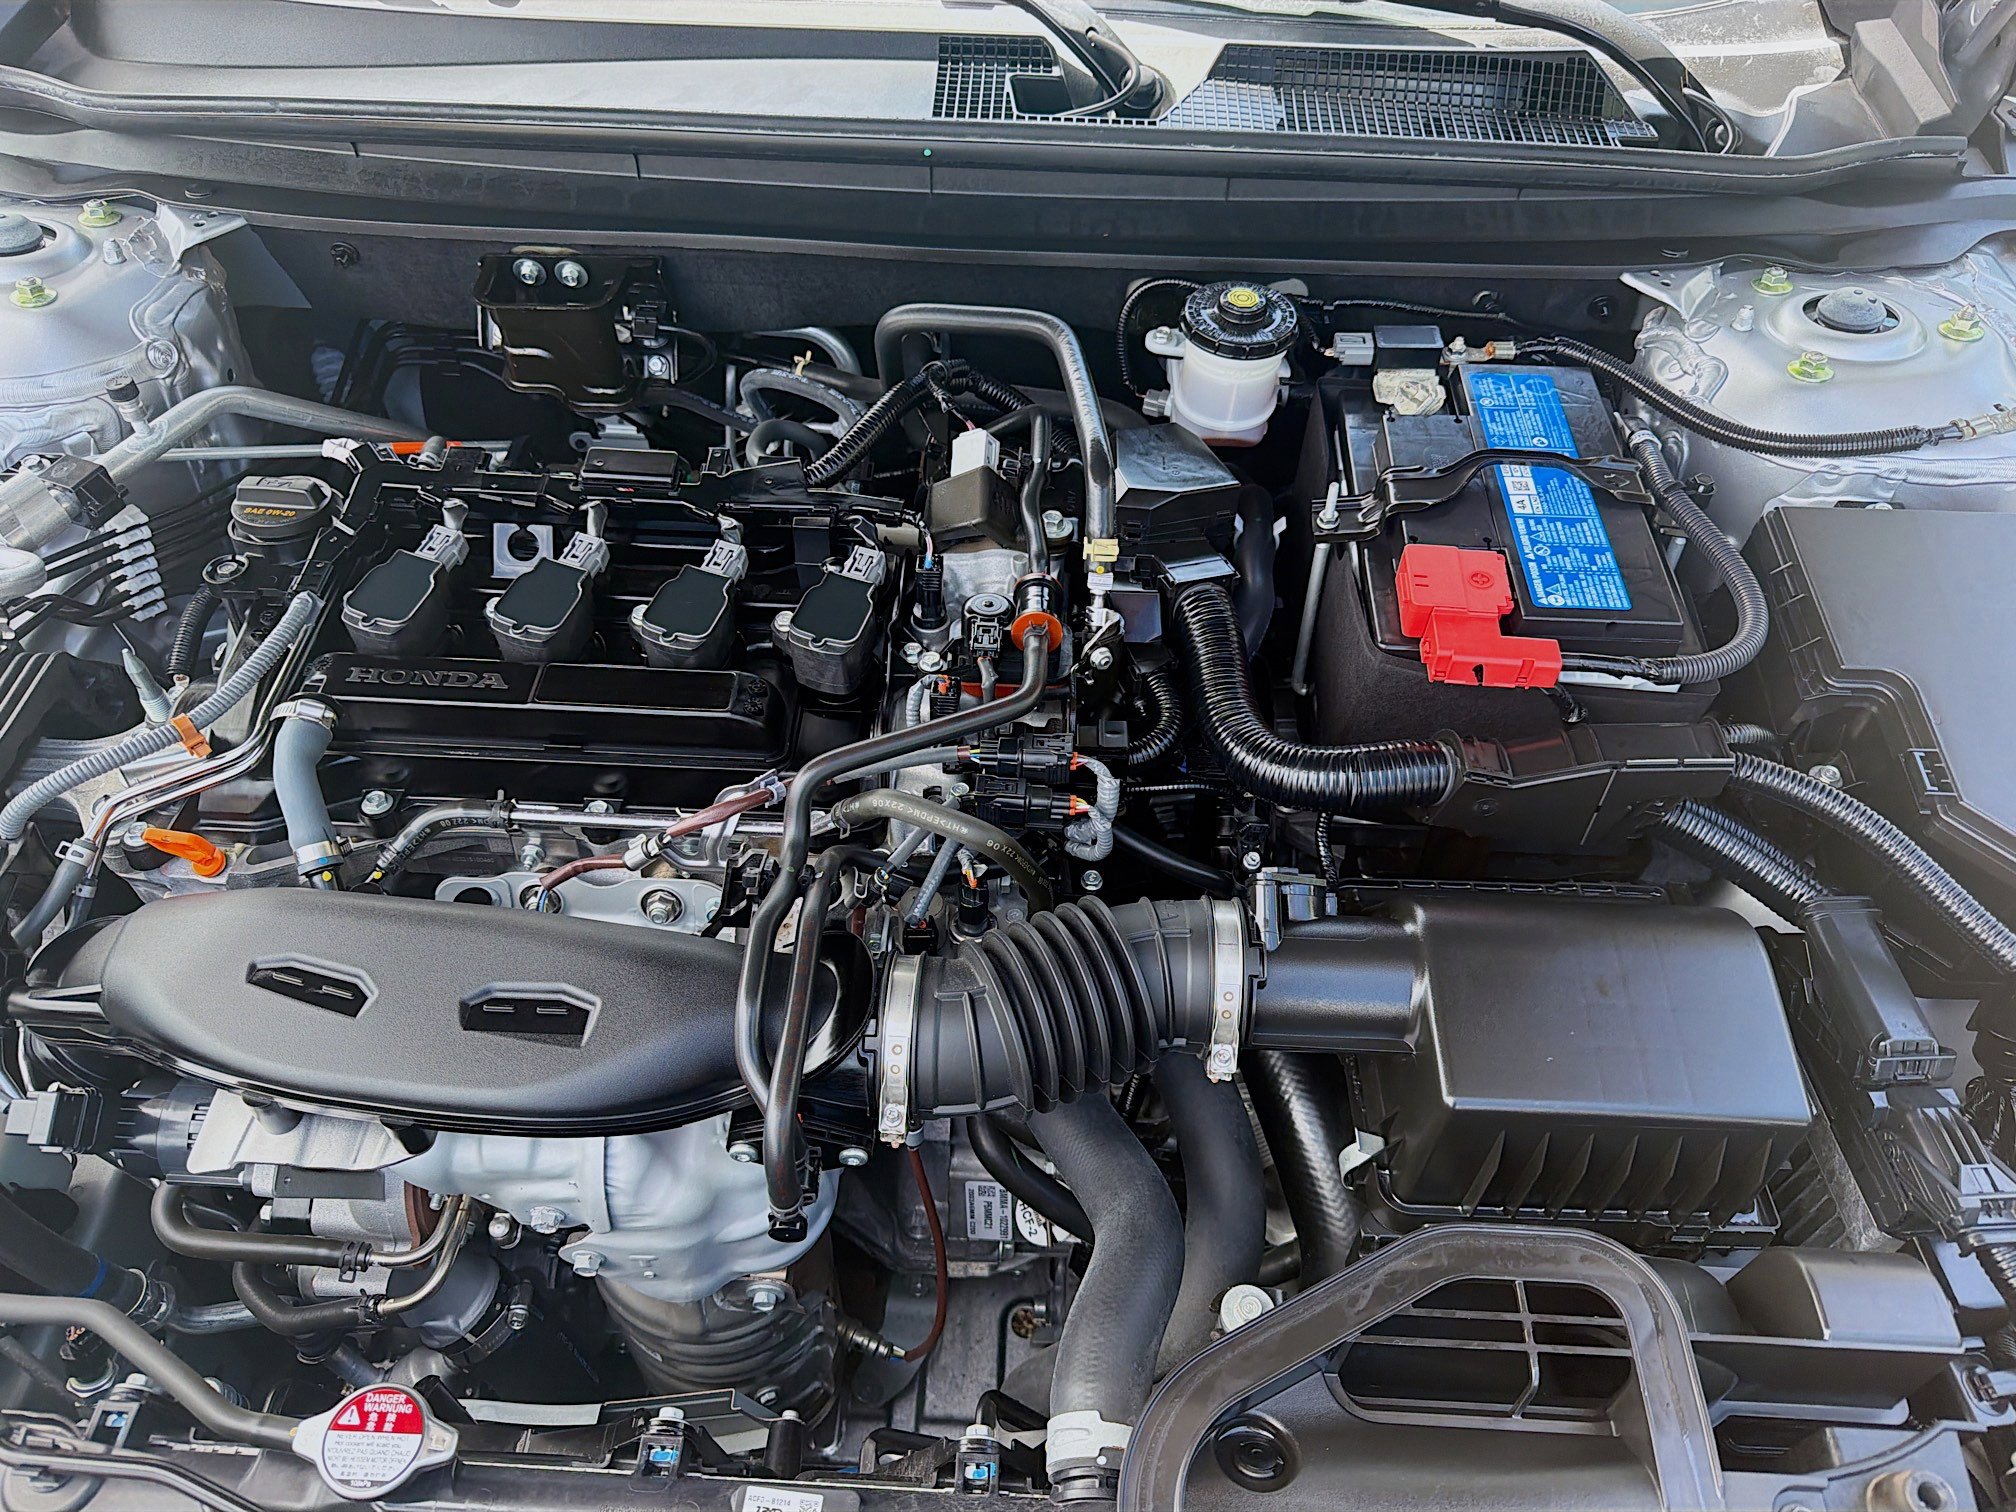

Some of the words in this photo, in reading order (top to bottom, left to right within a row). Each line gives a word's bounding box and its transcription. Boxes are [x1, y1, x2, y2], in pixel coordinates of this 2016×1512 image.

[266, 508, 296, 517] 0W-20
[345, 666, 509, 690] HONDA
[365, 1393, 407, 1404] DANGER
[364, 1402, 413, 1414] WARNUNG
